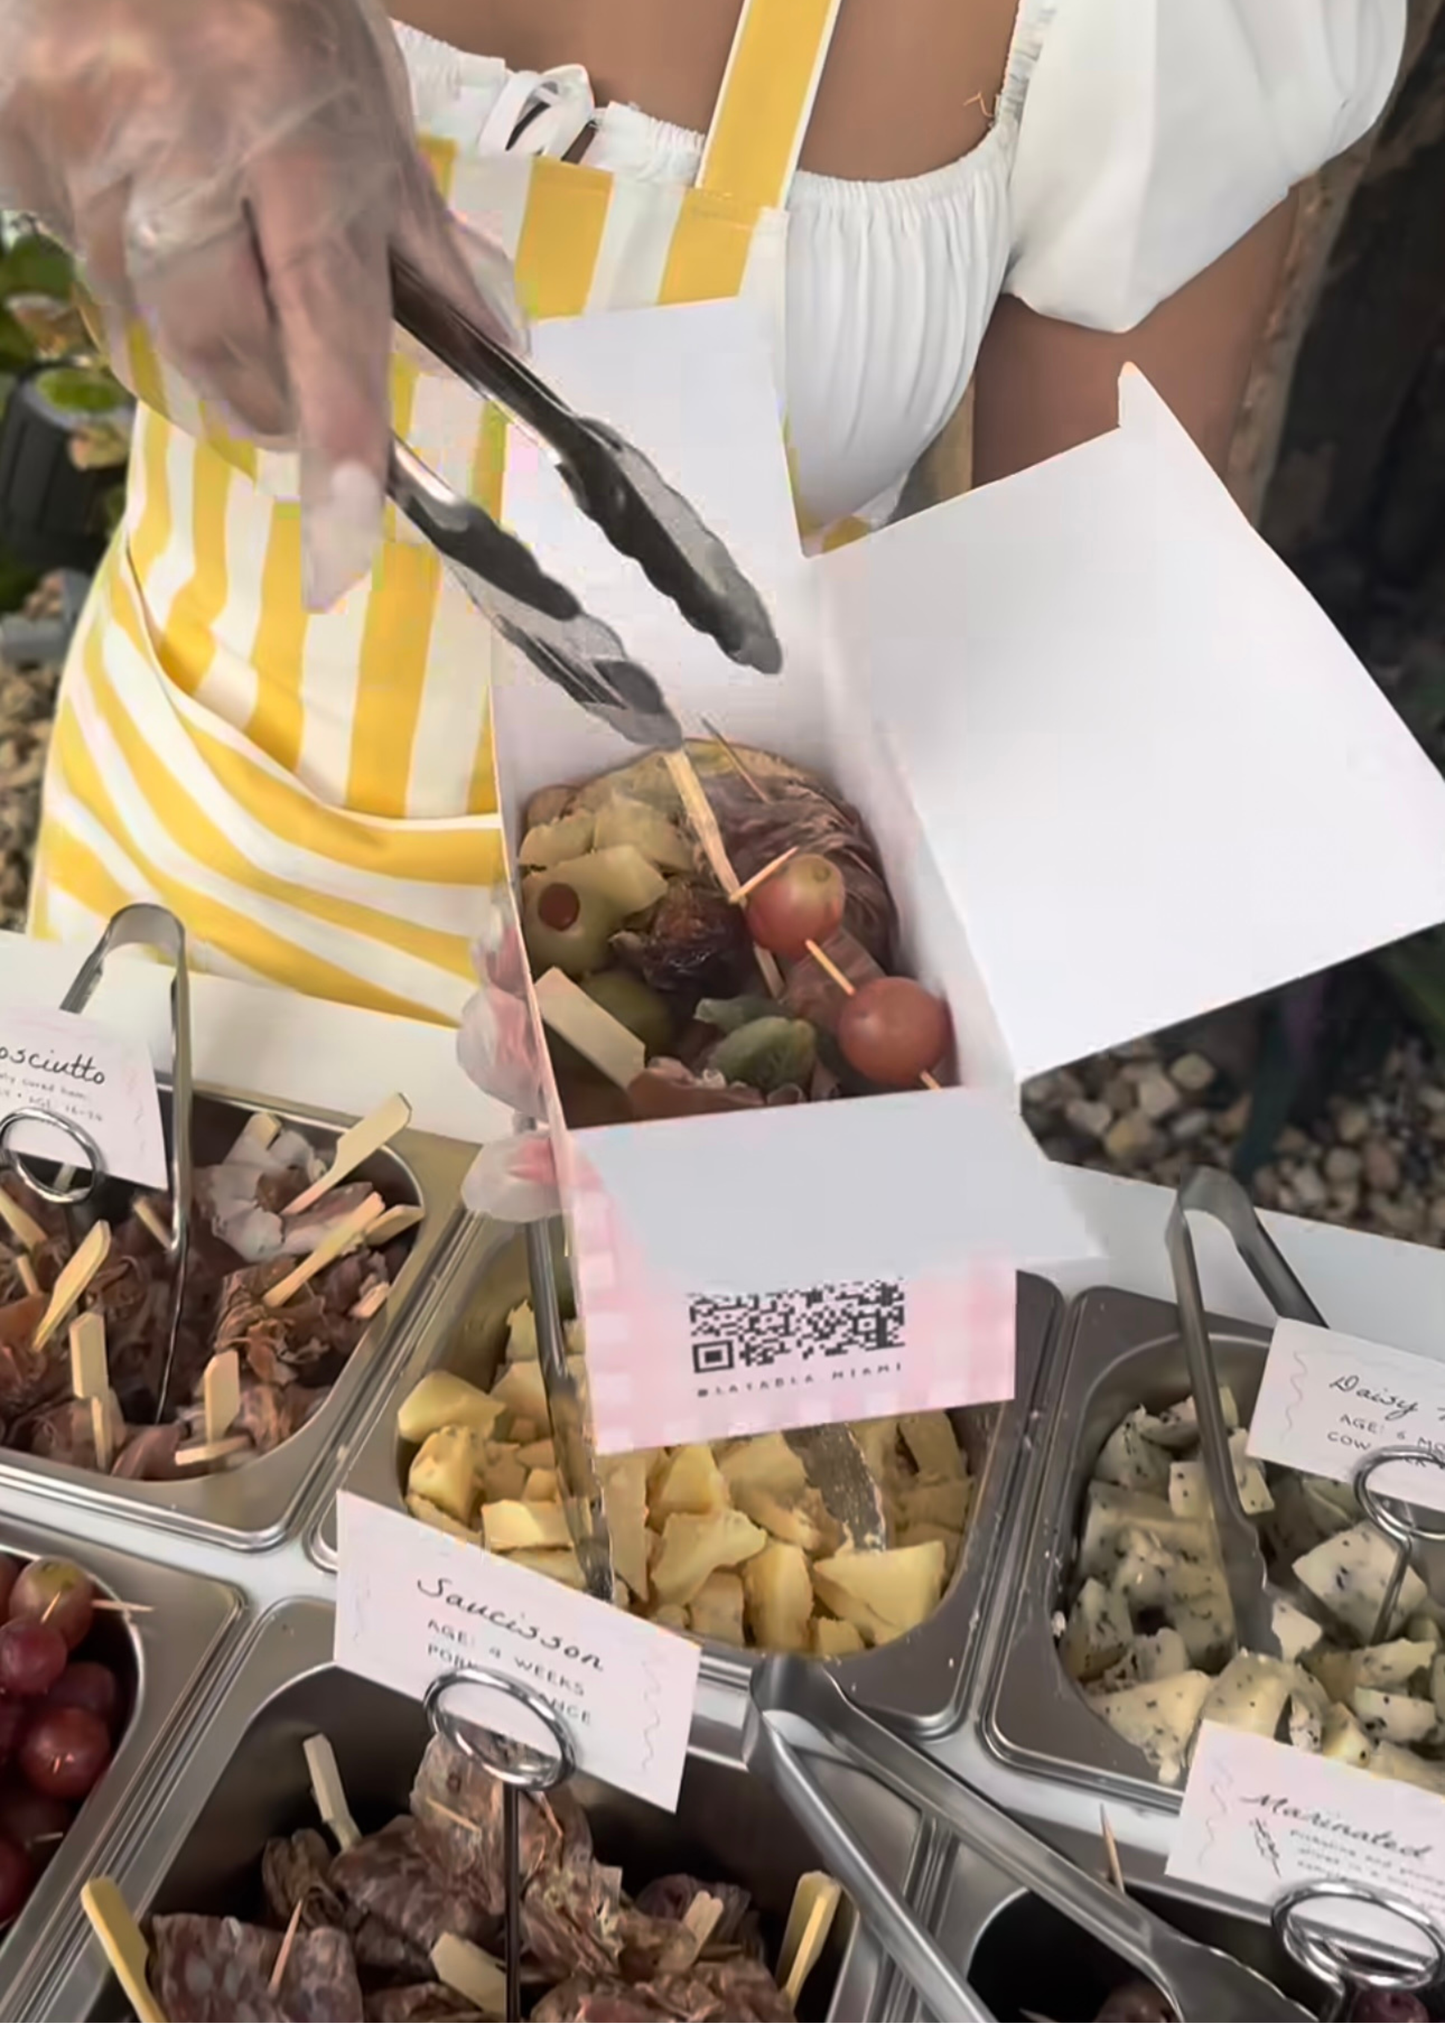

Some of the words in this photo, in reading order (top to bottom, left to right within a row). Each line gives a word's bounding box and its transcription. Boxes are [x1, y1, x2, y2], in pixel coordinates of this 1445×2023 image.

[831, 1361, 902, 1381] MIAMI
[1328, 1374, 1419, 1422] Daisy
[1326, 1431, 1372, 1452] COW
[416, 1576, 604, 1673] Saucisson
[513, 1655, 586, 1698] WEEKS
[1238, 1794, 1434, 1859] Marinated
